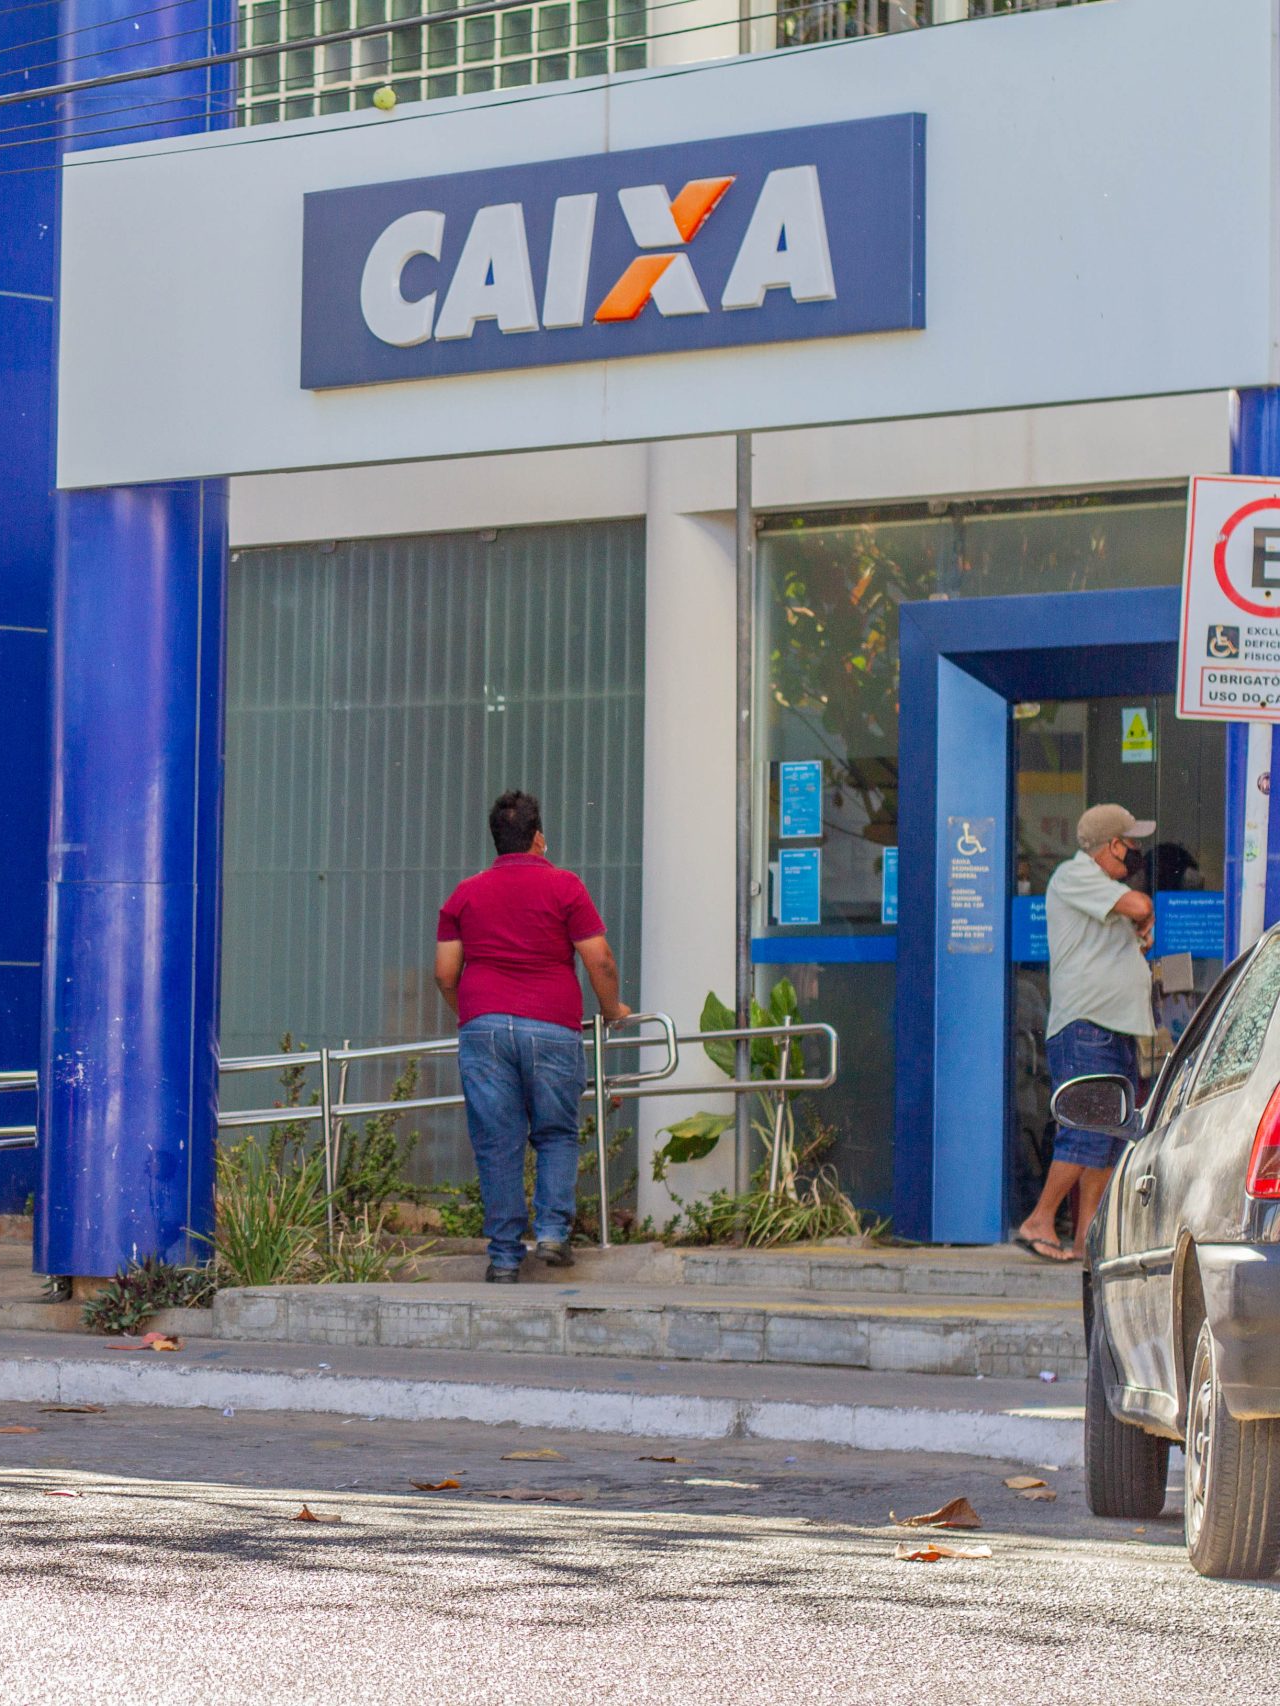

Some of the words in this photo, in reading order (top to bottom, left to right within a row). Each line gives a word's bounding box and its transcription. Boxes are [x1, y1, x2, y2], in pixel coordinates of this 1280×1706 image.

[360, 165, 836, 347] CAIXA
[1209, 691, 1237, 702] USO
[1243, 693, 1261, 703] DO
